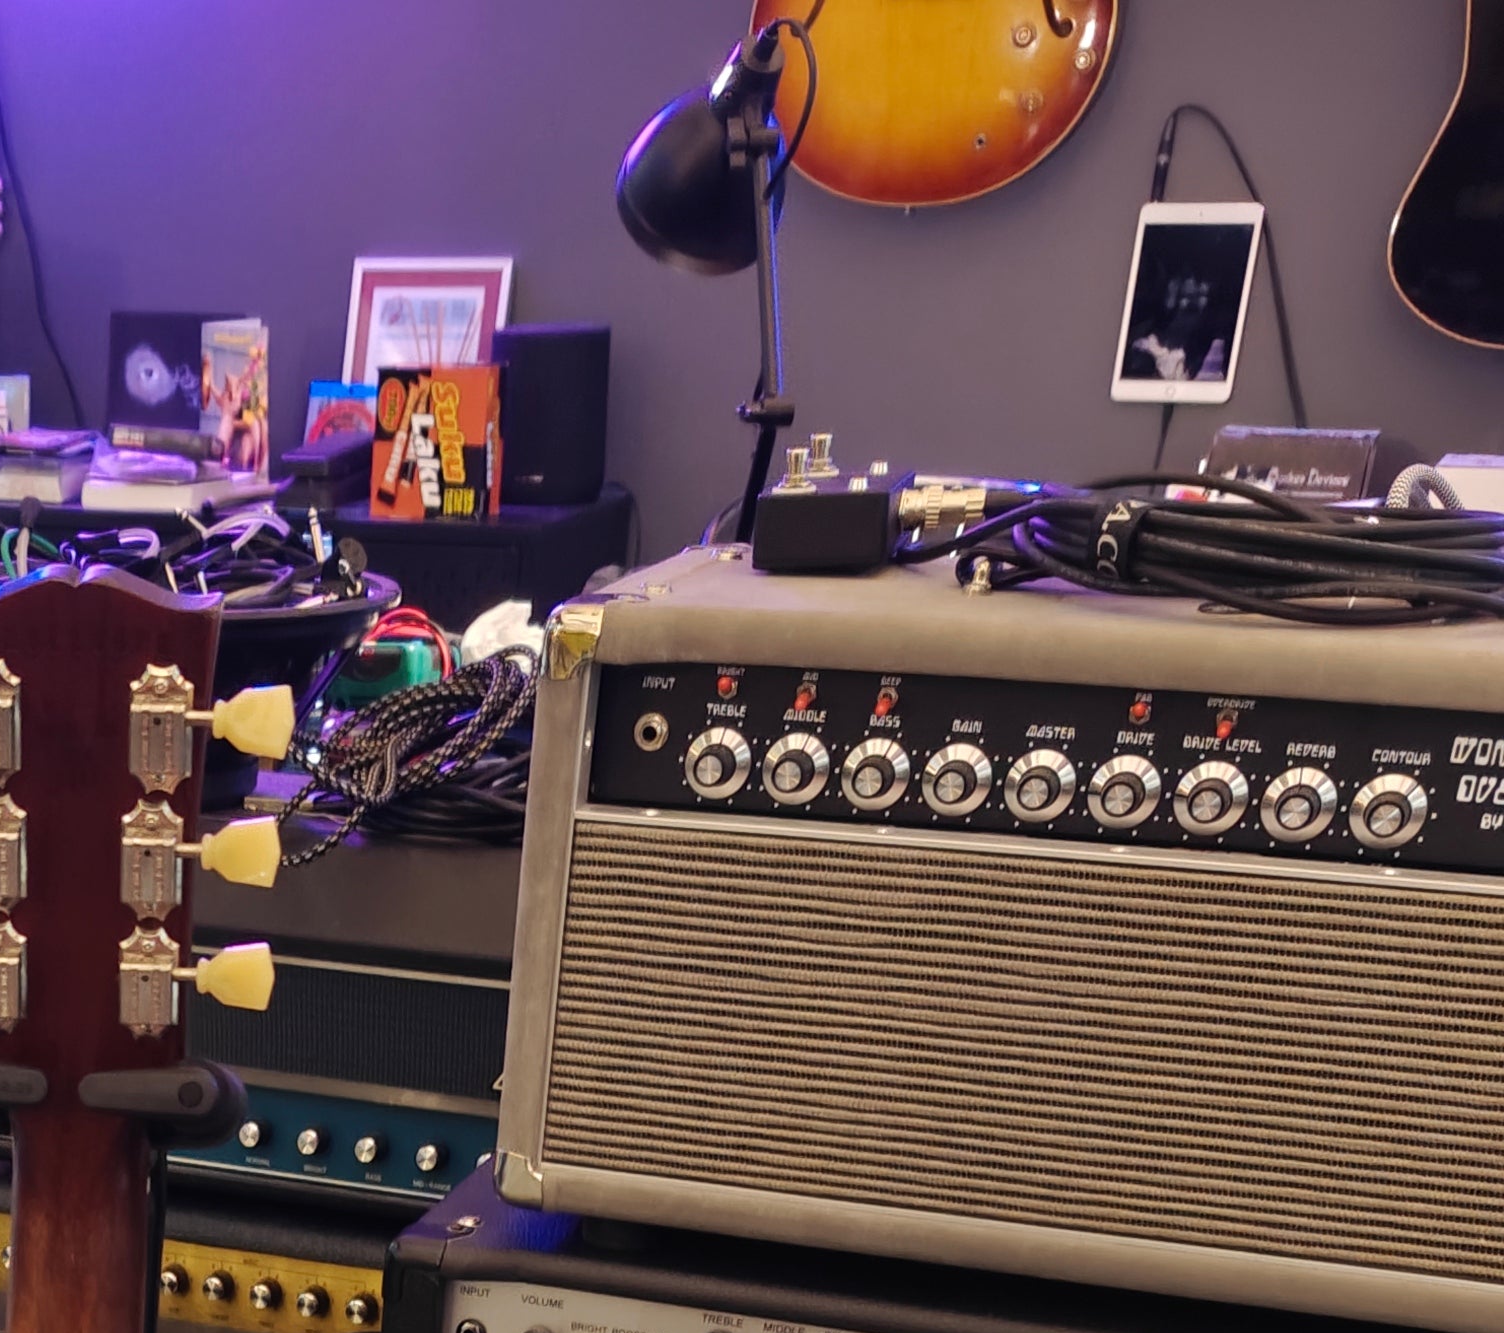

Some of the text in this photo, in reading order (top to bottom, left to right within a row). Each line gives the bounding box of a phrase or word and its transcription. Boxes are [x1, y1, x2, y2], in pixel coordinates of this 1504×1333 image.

[431, 381, 466, 485] Suku
[411, 413, 442, 509] Laku
[642, 676, 676, 690] INPUT
[706, 703, 747, 718] TREBLE
[783, 709, 827, 723] MIDDLE
[869, 715, 901, 728] BASS
[952, 719, 982, 734] GAIN
[1026, 724, 1076, 741] MASTER
[1117, 731, 1155, 746] DRIVE
[1183, 735, 1262, 753] DRIVE LEVEL
[1286, 742, 1336, 759] REVERB
[1371, 748, 1431, 766] CONTOUR
[459, 1286, 492, 1298] INPUT
[522, 1294, 564, 1309] VOLUME
[702, 1313, 743, 1328] TREBLE
